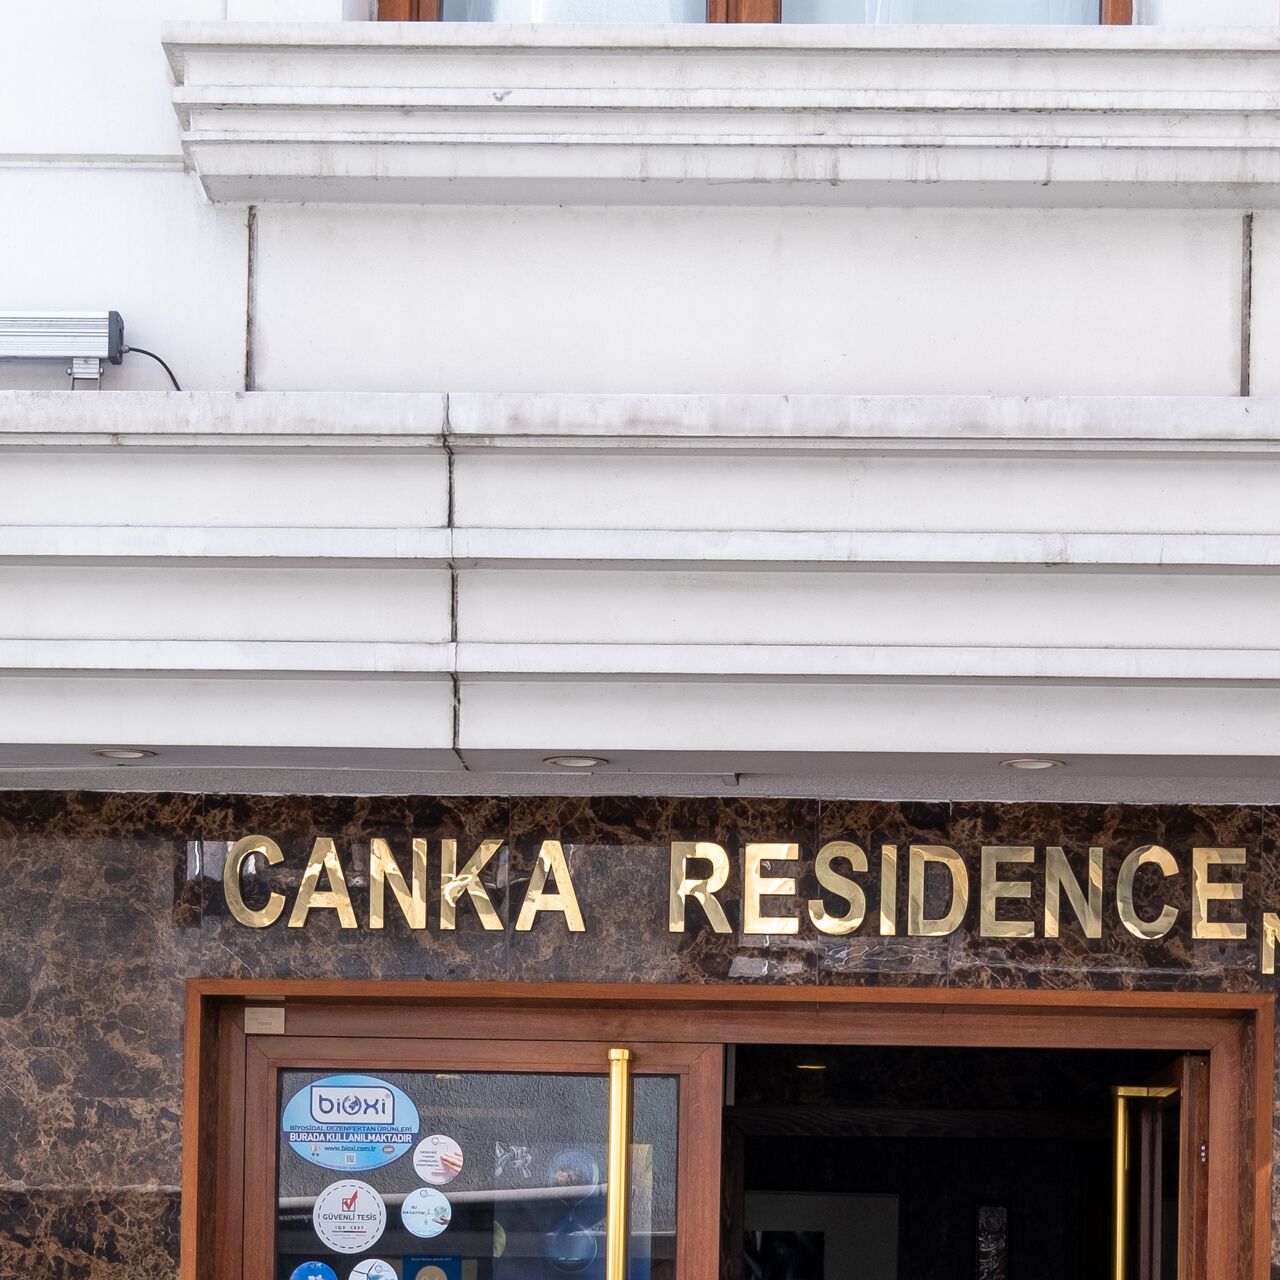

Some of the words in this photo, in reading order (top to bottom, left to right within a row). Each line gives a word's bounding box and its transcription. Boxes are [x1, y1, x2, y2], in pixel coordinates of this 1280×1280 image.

[223, 836, 587, 933] CANKA
[666, 839, 1249, 941] RESIDENCE
[318, 1093, 386, 1116] bioxi
[289, 1132, 325, 1142] BURADA
[325, 1133, 413, 1143] KULLANILMAKTADIR
[324, 1145, 377, 1153] www.bioxi.com.tr
[322, 1212, 355, 1221] GÜVENLİ
[356, 1212, 377, 1221] TESİS
